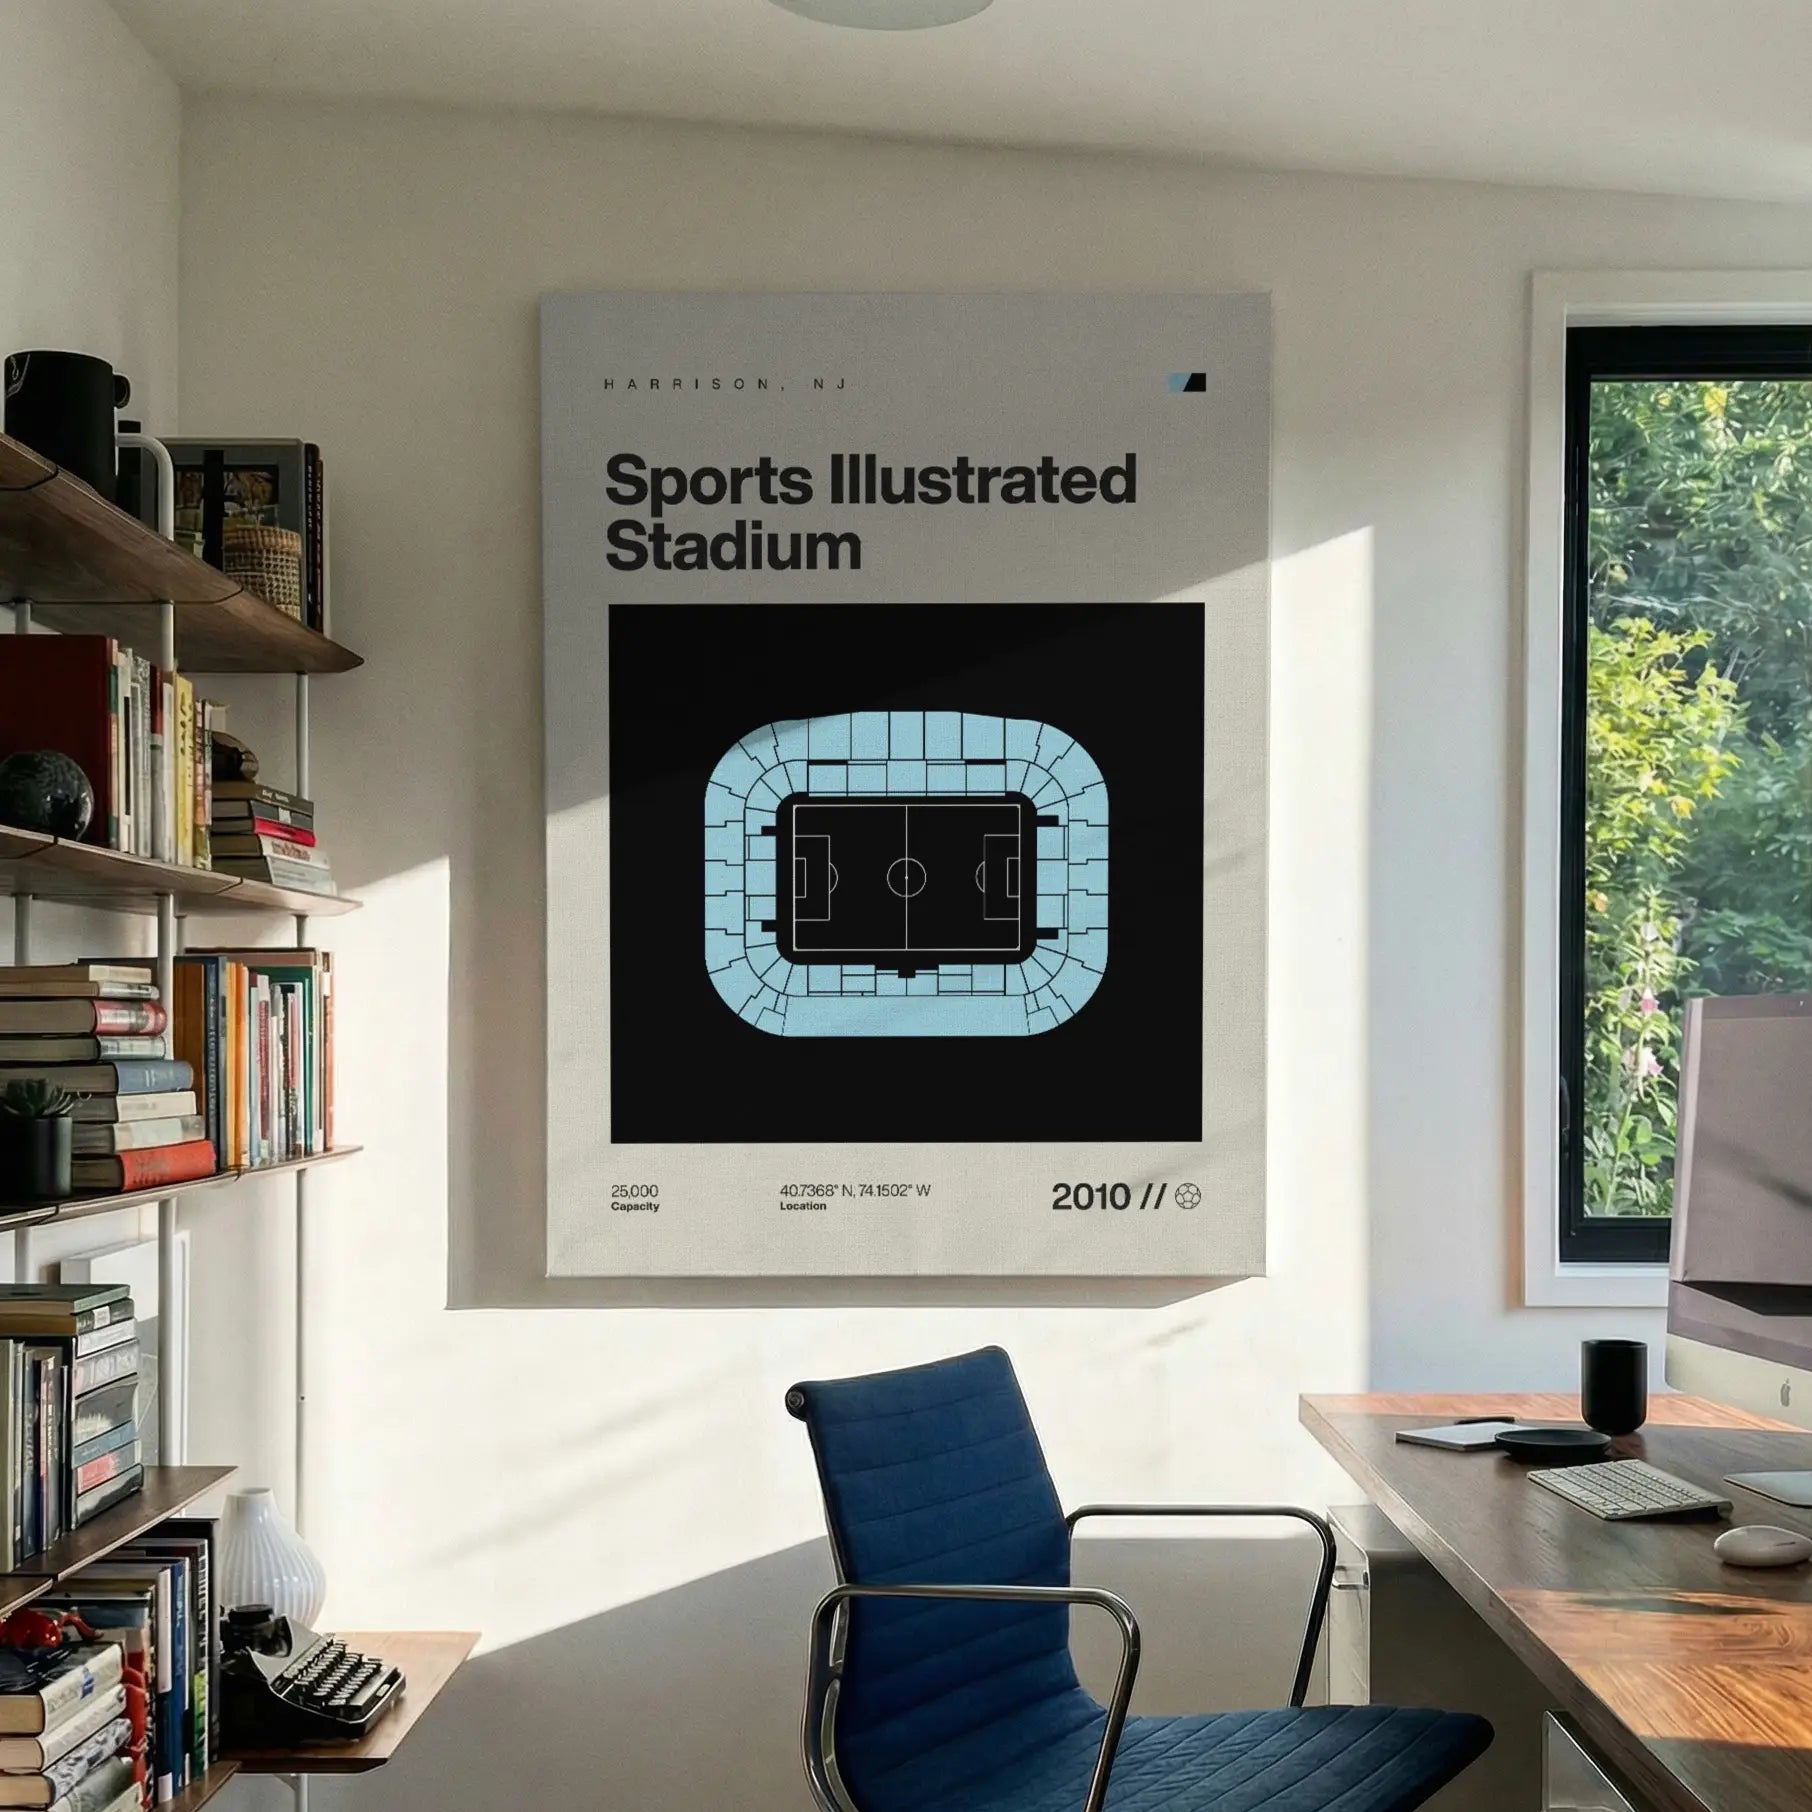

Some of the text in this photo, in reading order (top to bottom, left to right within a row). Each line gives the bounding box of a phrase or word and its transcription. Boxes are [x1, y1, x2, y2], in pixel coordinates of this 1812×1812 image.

[603, 377, 845, 392] HARRISON, NJ
[605, 452, 1137, 518] Sports Illustrated
[605, 519, 862, 572] Stadium
[611, 1184, 659, 1199] 25,000
[779, 1183, 932, 1199] 40.7368° N, 74.1502° W
[1052, 1182, 1132, 1211] 2010
[610, 1201, 661, 1213] Capacity
[779, 1200, 827, 1211] Location
